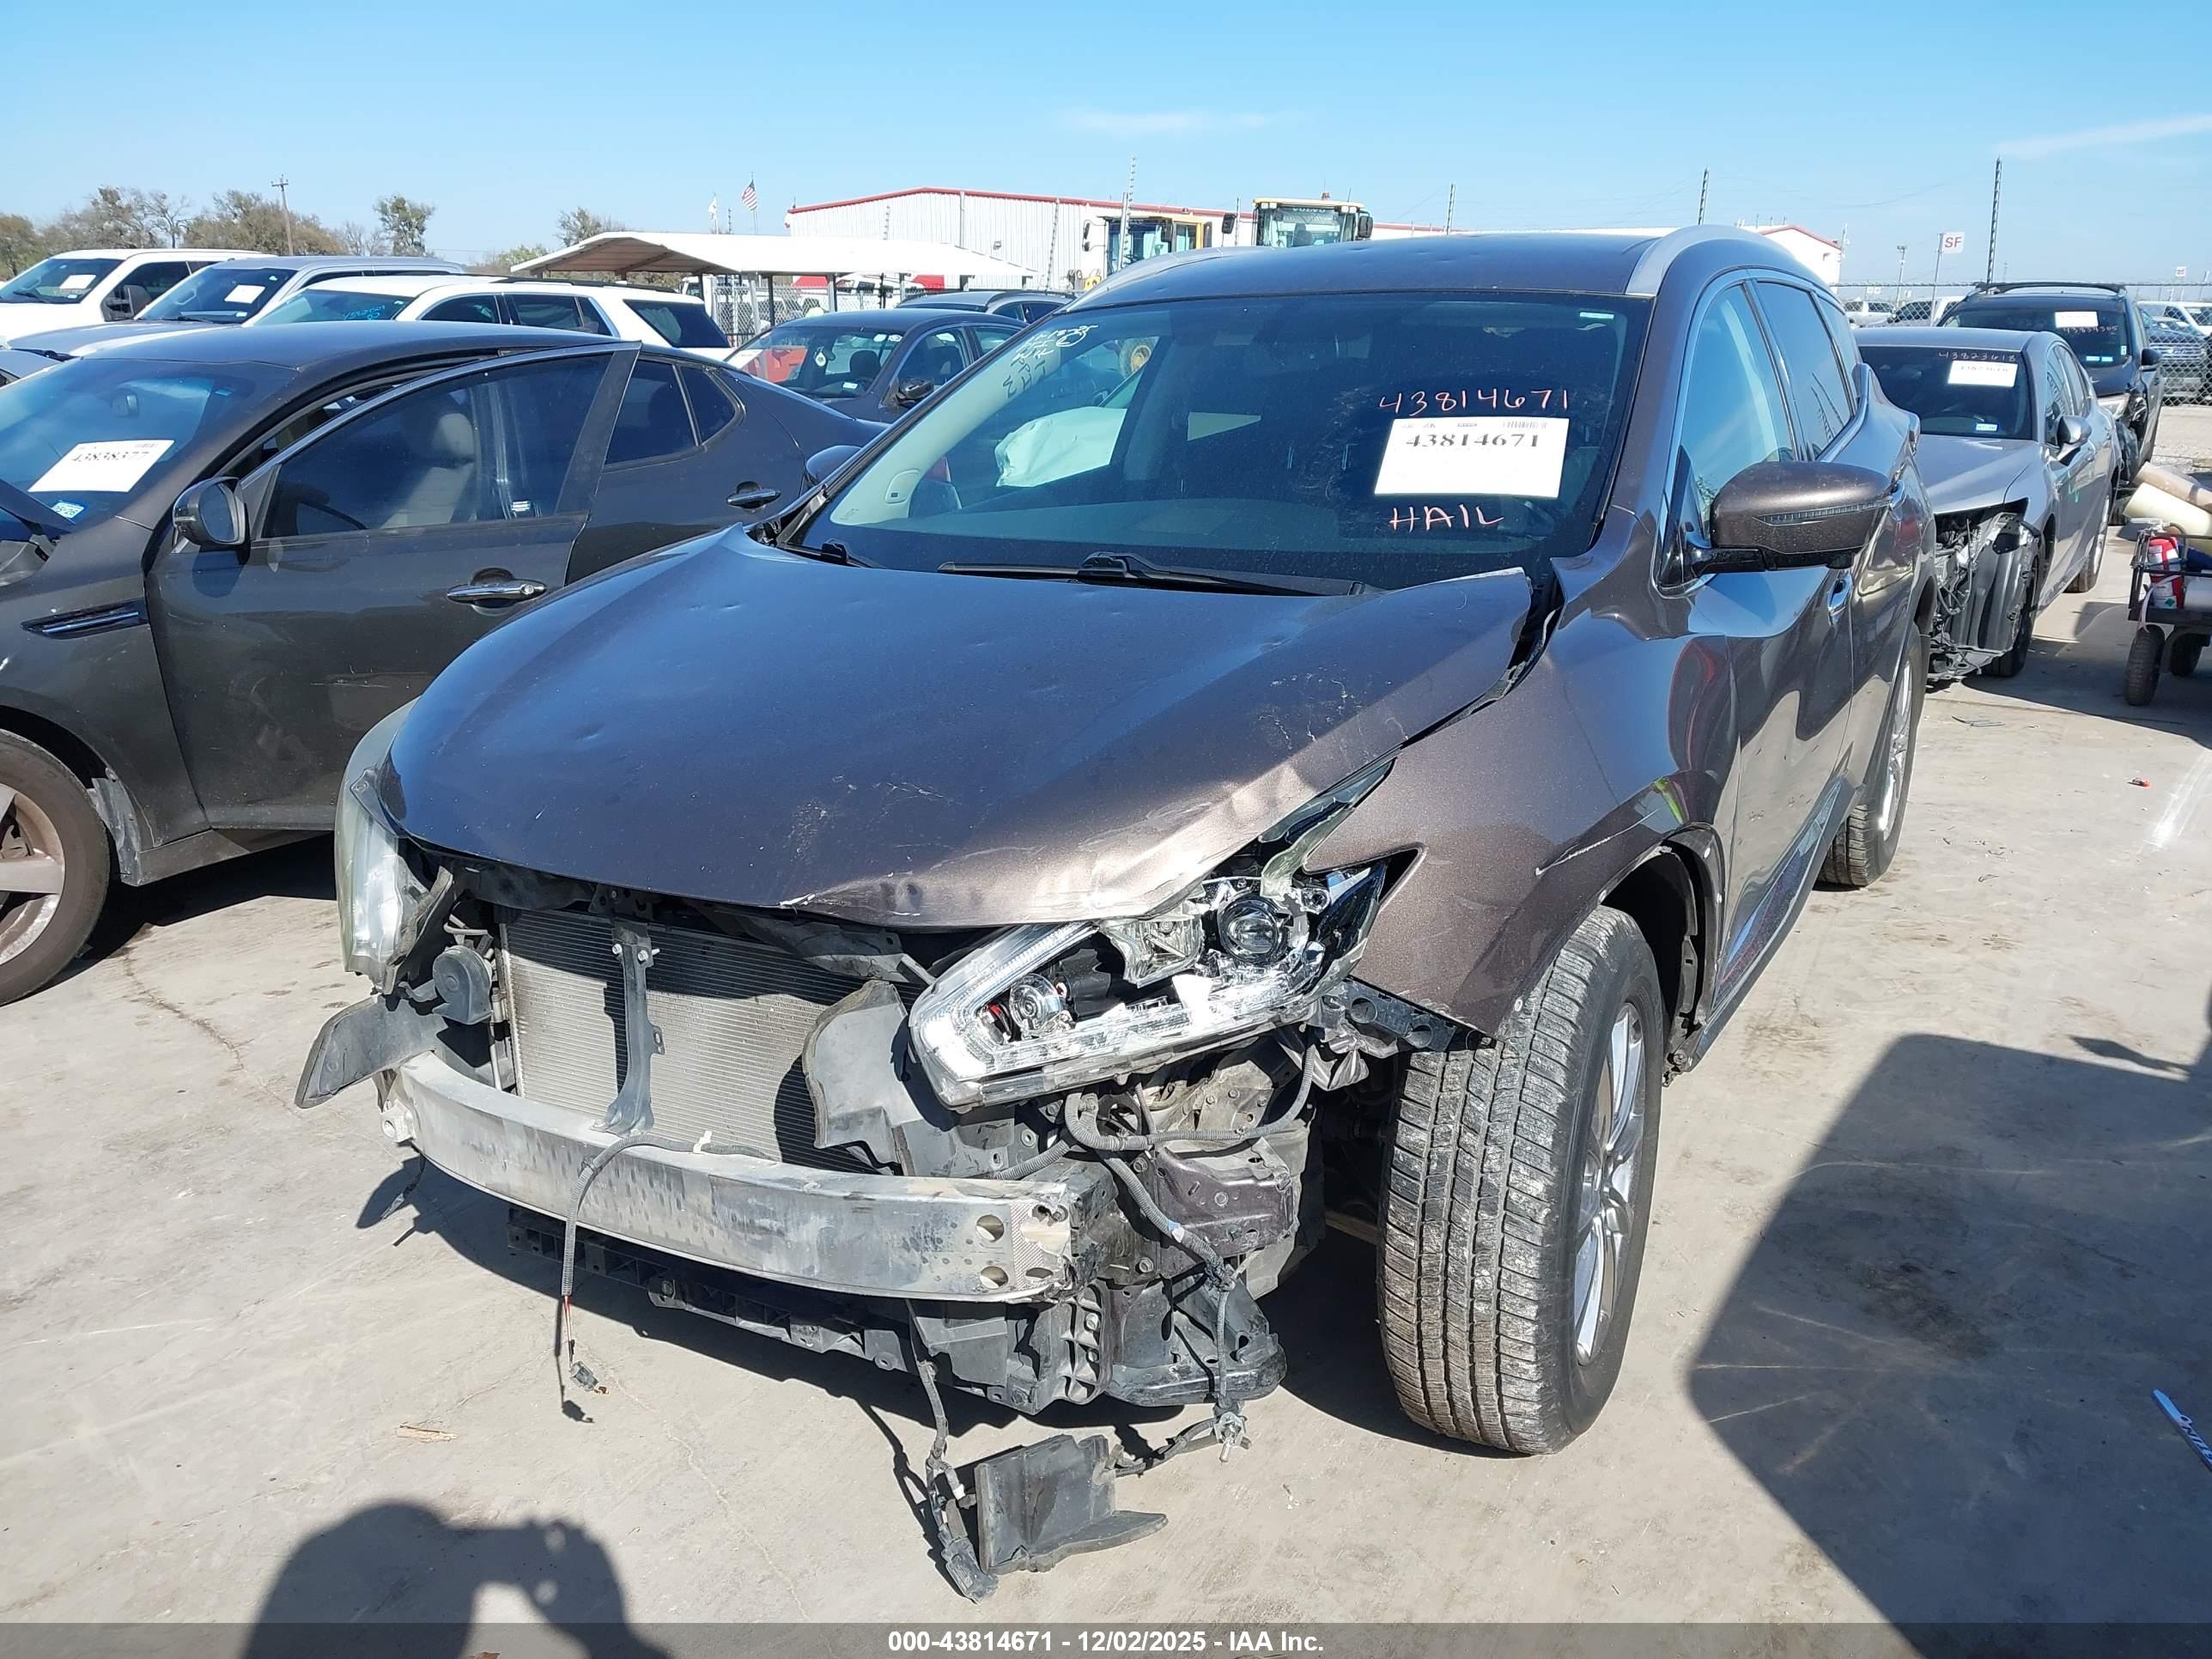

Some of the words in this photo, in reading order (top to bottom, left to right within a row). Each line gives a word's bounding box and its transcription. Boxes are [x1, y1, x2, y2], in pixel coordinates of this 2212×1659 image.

[1944, 236, 1962, 248] SF
[1379, 388, 1568, 416] 43814671
[1405, 433, 1540, 447] 43814671
[1389, 503, 1504, 532] HAIL
